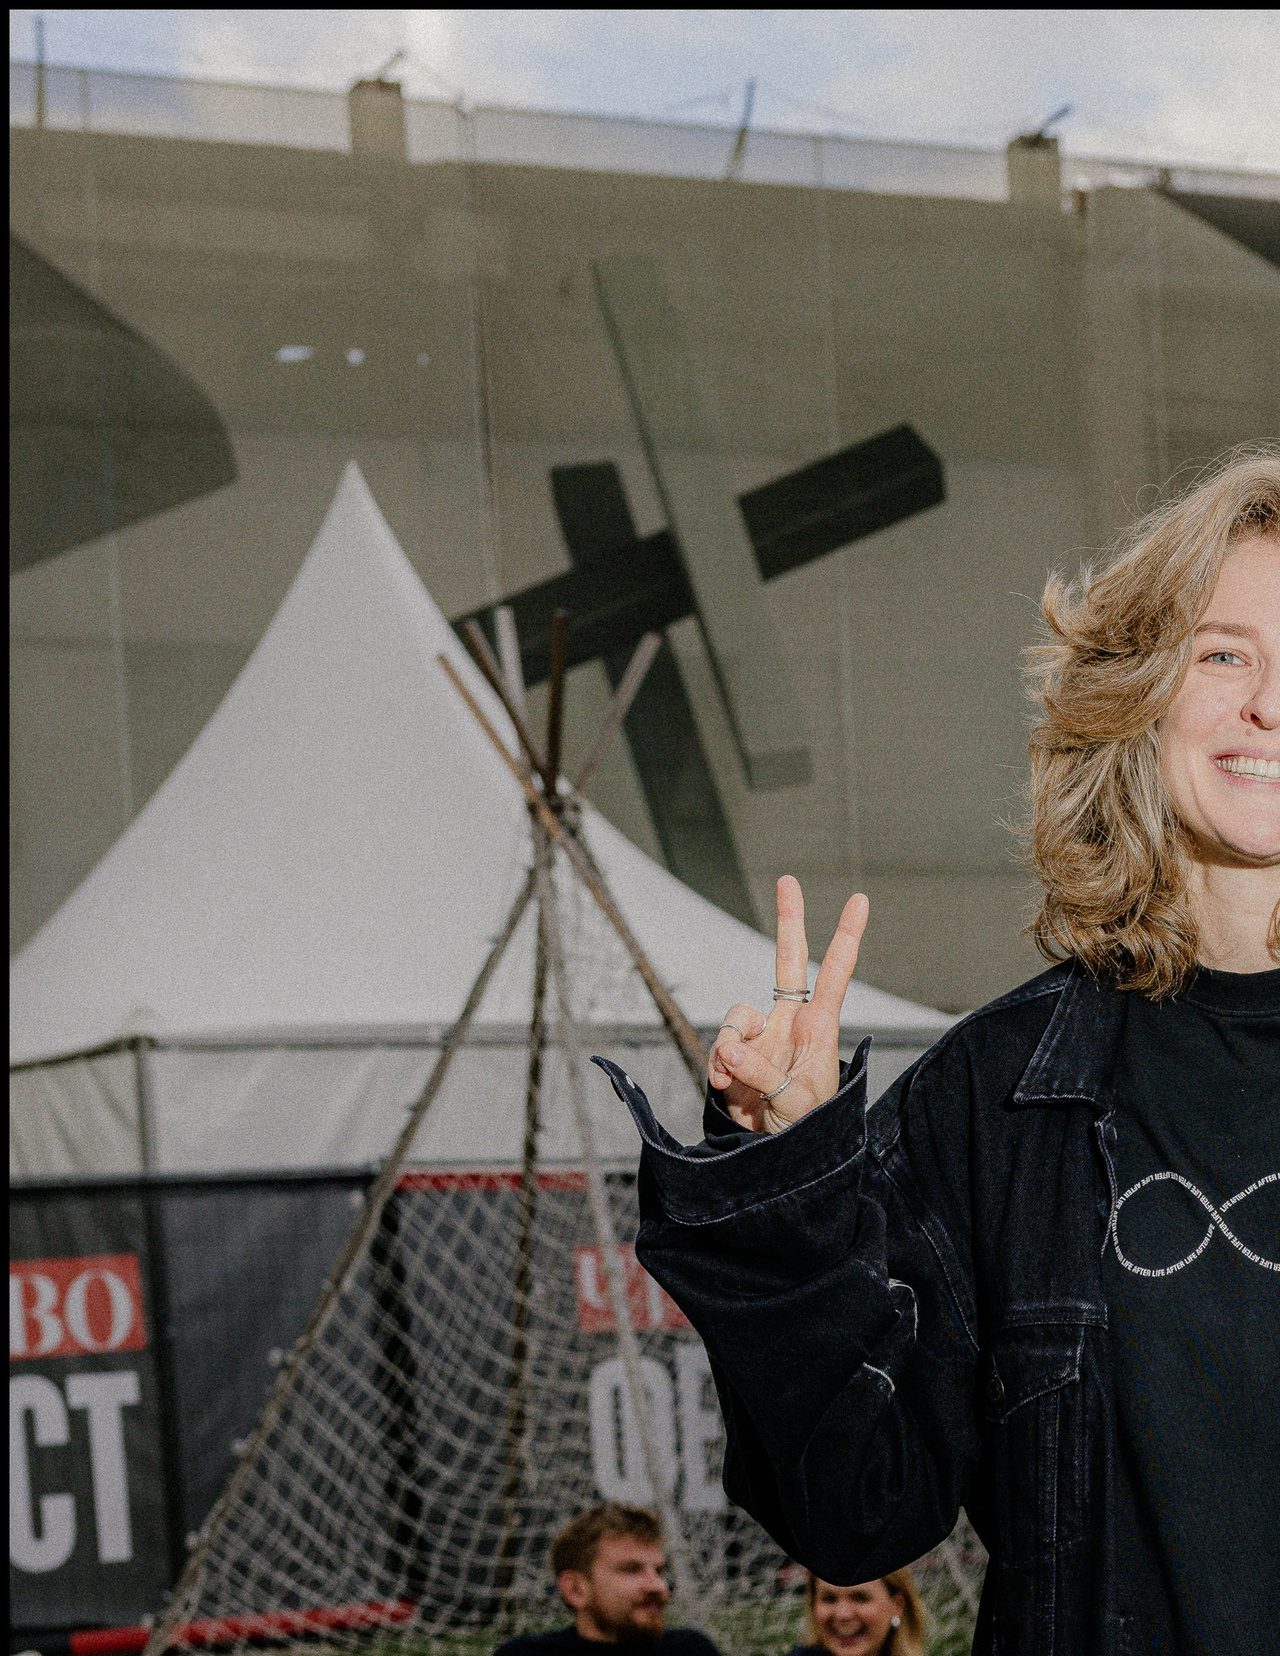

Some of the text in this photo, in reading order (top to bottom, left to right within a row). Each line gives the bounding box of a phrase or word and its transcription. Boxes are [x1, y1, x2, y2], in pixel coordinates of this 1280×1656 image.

[1140, 1174, 1154, 1187] LIFE
[1178, 1174, 1193, 1190] AFTER
[1123, 1182, 1141, 1199] AFTER
[1190, 1185, 1203, 1199] LIFE
[1220, 1200, 1233, 1213] LIFE
[1230, 1191, 1247, 1205] AFTER
[1244, 1183, 1259, 1195] LIFE
[1257, 1173, 1278, 1188] AFTER
[1115, 1196, 1126, 1210] LIFE
[1199, 1195, 1215, 1213] AFTER
[1210, 1210, 1223, 1225] LIFE
[1206, 1223, 1216, 1239] LIFE
[1219, 1221, 1235, 1240] AFTER
[1195, 1236, 1211, 1256] AFTER
[1230, 1236, 1244, 1251] LIFE
[1183, 1252, 1198, 1265] LIFE
[1241, 1246, 1261, 1263] AFTER
[1120, 1258, 1134, 1271] LIFE
[1132, 1265, 1151, 1277] AFTER
[1166, 1260, 1186, 1275] AFTER
[1259, 1258, 1273, 1270] LIFE
[1151, 1269, 1166, 1278] LIFE
